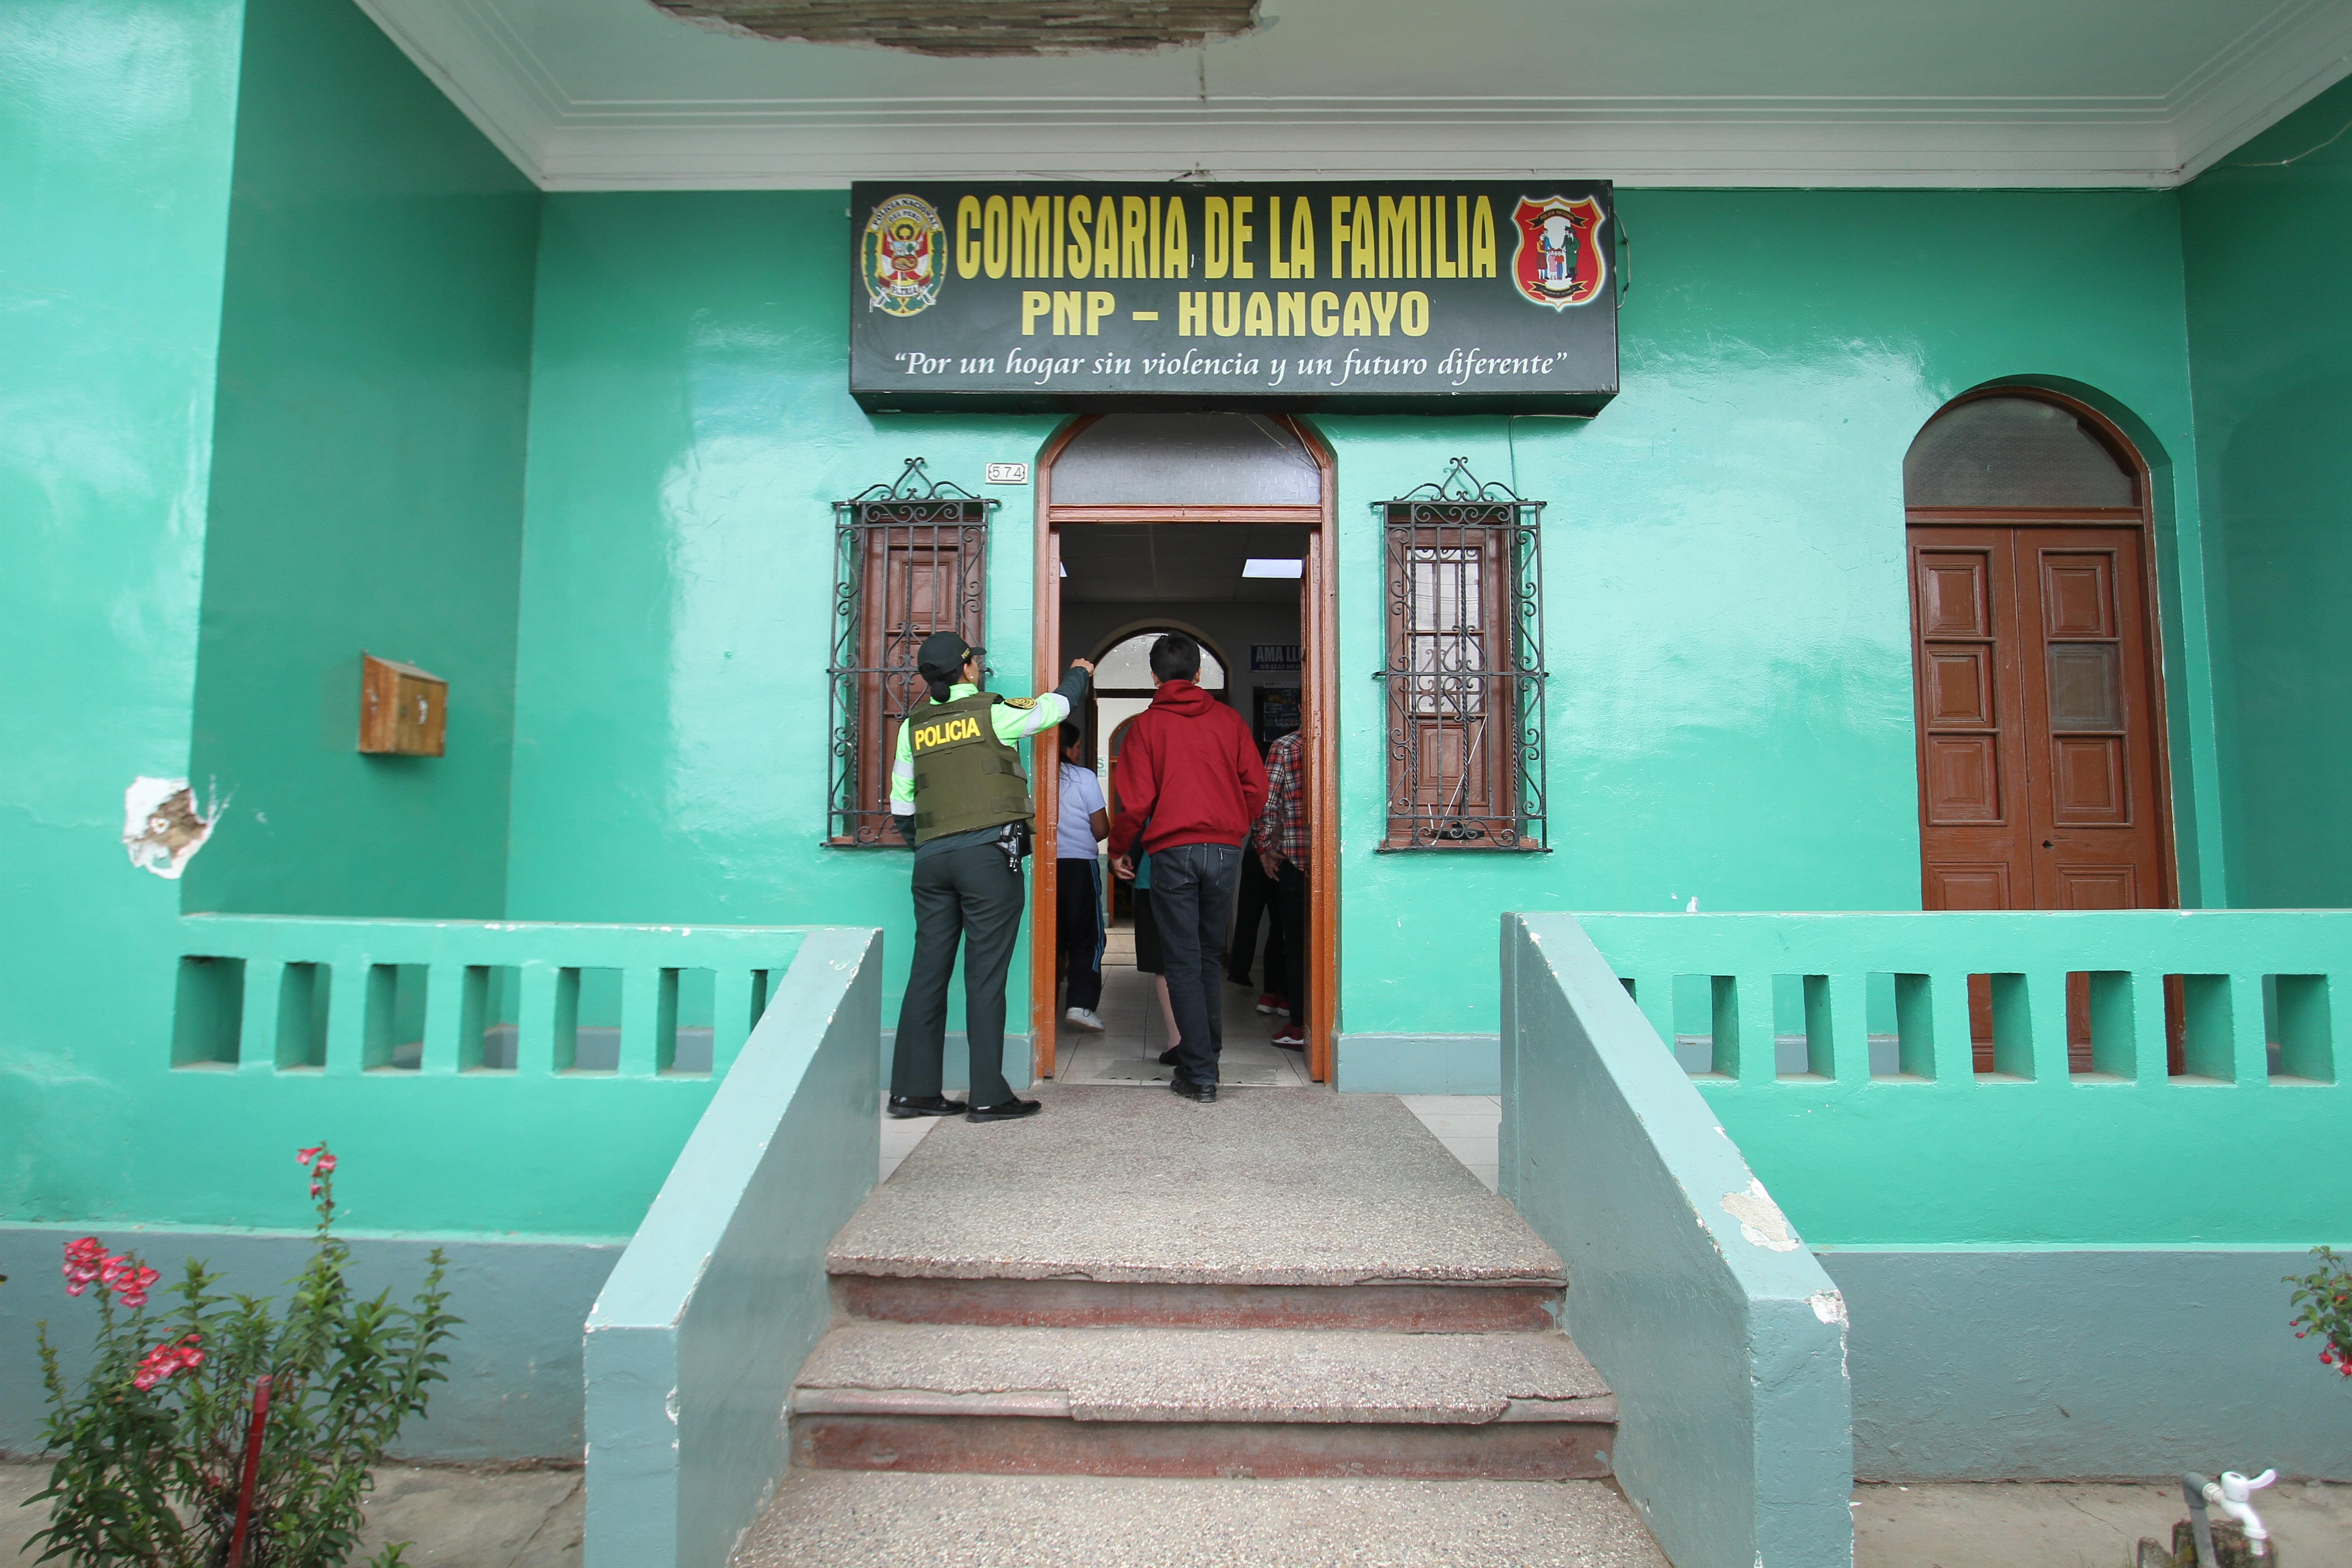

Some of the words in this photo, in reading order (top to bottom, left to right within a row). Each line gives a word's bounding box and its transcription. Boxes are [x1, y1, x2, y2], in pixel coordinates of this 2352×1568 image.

[873, 200, 900, 226] POLICIA
[901, 199, 938, 227] NACIONAL
[956, 195, 1189, 279] COMISARIA
[1205, 196, 1254, 279] DE
[1270, 196, 1315, 279] LA
[1331, 195, 1497, 279] FAMILIA
[1022, 291, 1115, 336] PNP
[1178, 290, 1430, 337] HUANCAYO
[960, 358, 995, 374] un
[1005, 347, 1086, 385] hogar
[1092, 352, 1132, 375] sin
[1142, 348, 1260, 375] violencia
[1268, 358, 1287, 387] y
[1297, 359, 1332, 375] un
[1330, 348, 1428, 387] futuro
[993, 466, 1022, 478] 574
[1255, 646, 1283, 662] AMA
[914, 716, 982, 751] POLICIA
